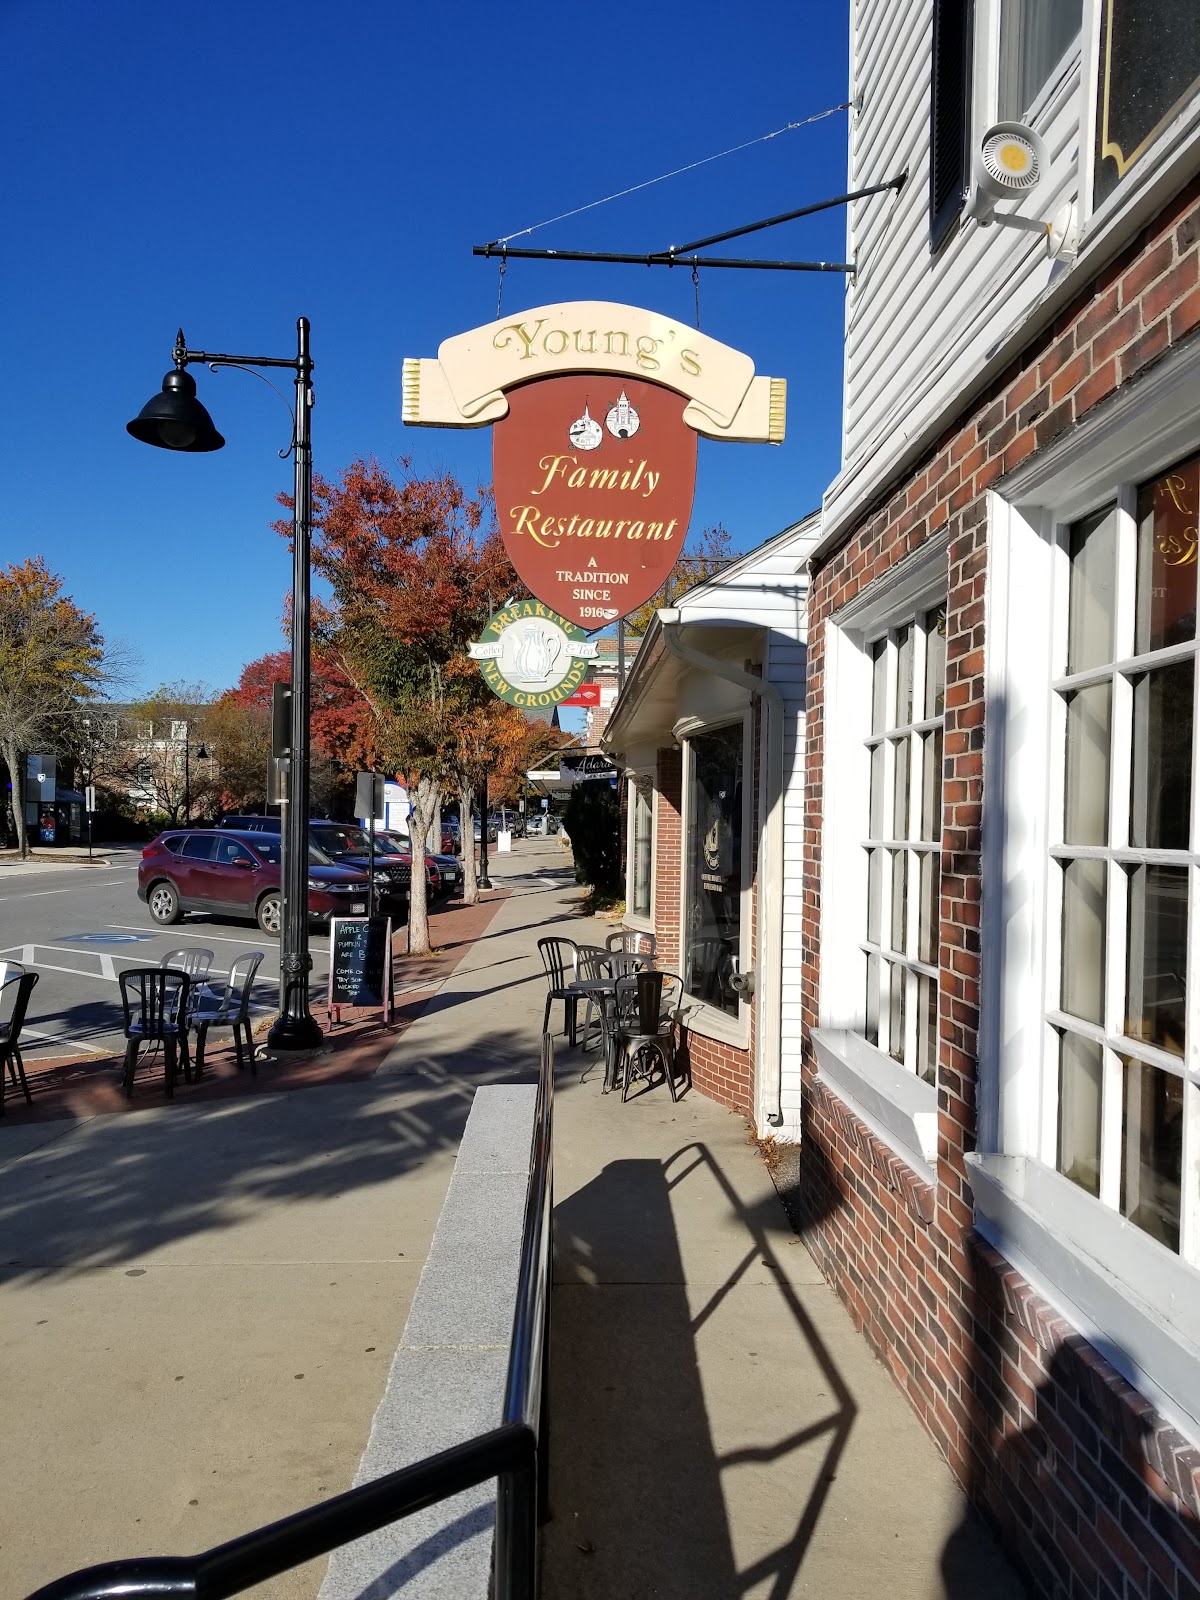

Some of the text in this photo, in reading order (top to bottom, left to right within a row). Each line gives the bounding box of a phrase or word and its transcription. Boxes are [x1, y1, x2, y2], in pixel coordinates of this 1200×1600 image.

[492, 318, 702, 377] Young's
[530, 455, 660, 497] Family
[509, 505, 678, 548] Restaurant
[587, 557, 598, 567] A
[556, 571, 629, 584] TRADITION
[572, 589, 611, 600] SINCE
[489, 603, 577, 634] BREAKING
[579, 606, 604, 618] 1916
[475, 645, 502, 657] Coffee
[578, 644, 594, 656] Tea
[483, 660, 585, 707] NEW GROUNDS
[340, 924, 360, 934] APPLE
